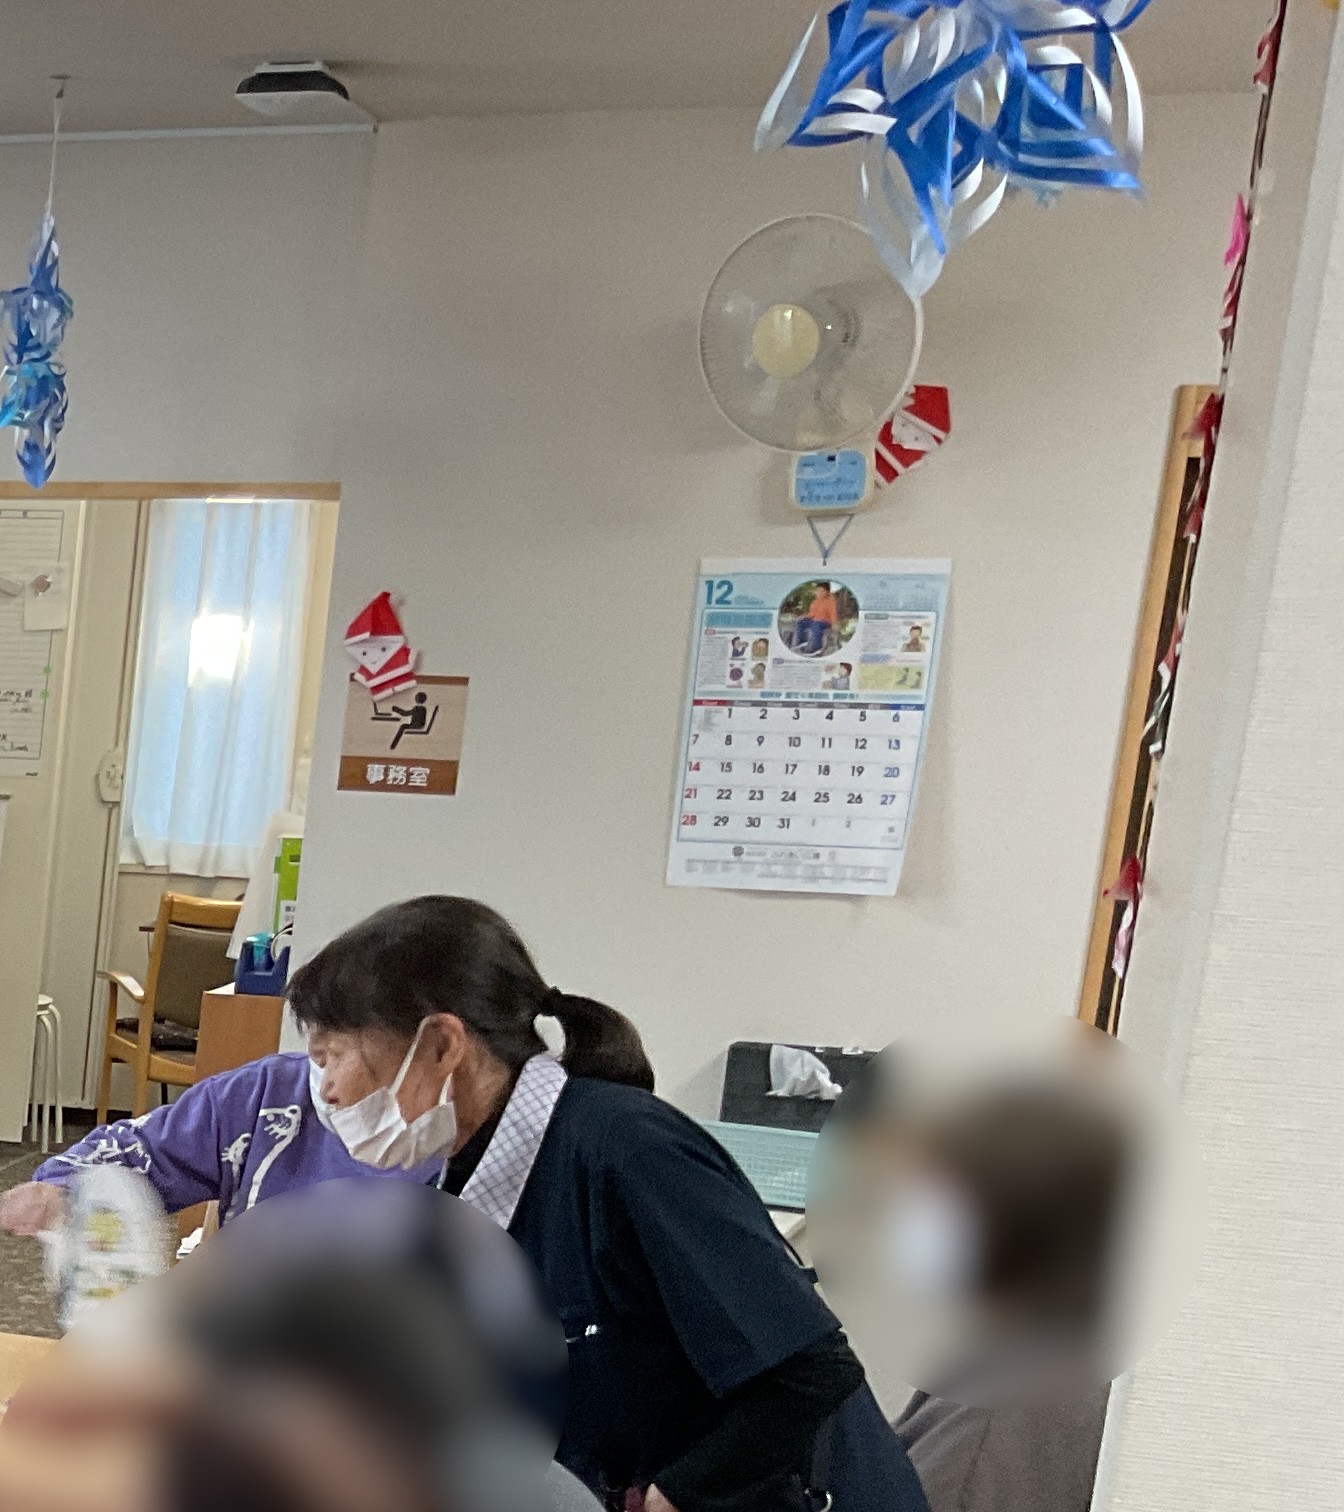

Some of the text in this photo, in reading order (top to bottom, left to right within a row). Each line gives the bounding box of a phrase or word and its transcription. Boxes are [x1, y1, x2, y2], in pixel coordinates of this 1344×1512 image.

[705, 580, 733, 605] 12
[728, 708, 900, 722] 1 2 3 4 5 6
[692, 734, 900, 750] 7 8 9 10 11 12 13
[366, 764, 430, 787] 事務室
[688, 761, 900, 777] 14 15 16 17 18 19 20
[684, 788, 896, 805] 21 22 23 24 25 26 27
[682, 815, 697, 825] 28
[714, 816, 729, 826] 29
[746, 817, 760, 827] 30
[777, 818, 790, 828] 31
